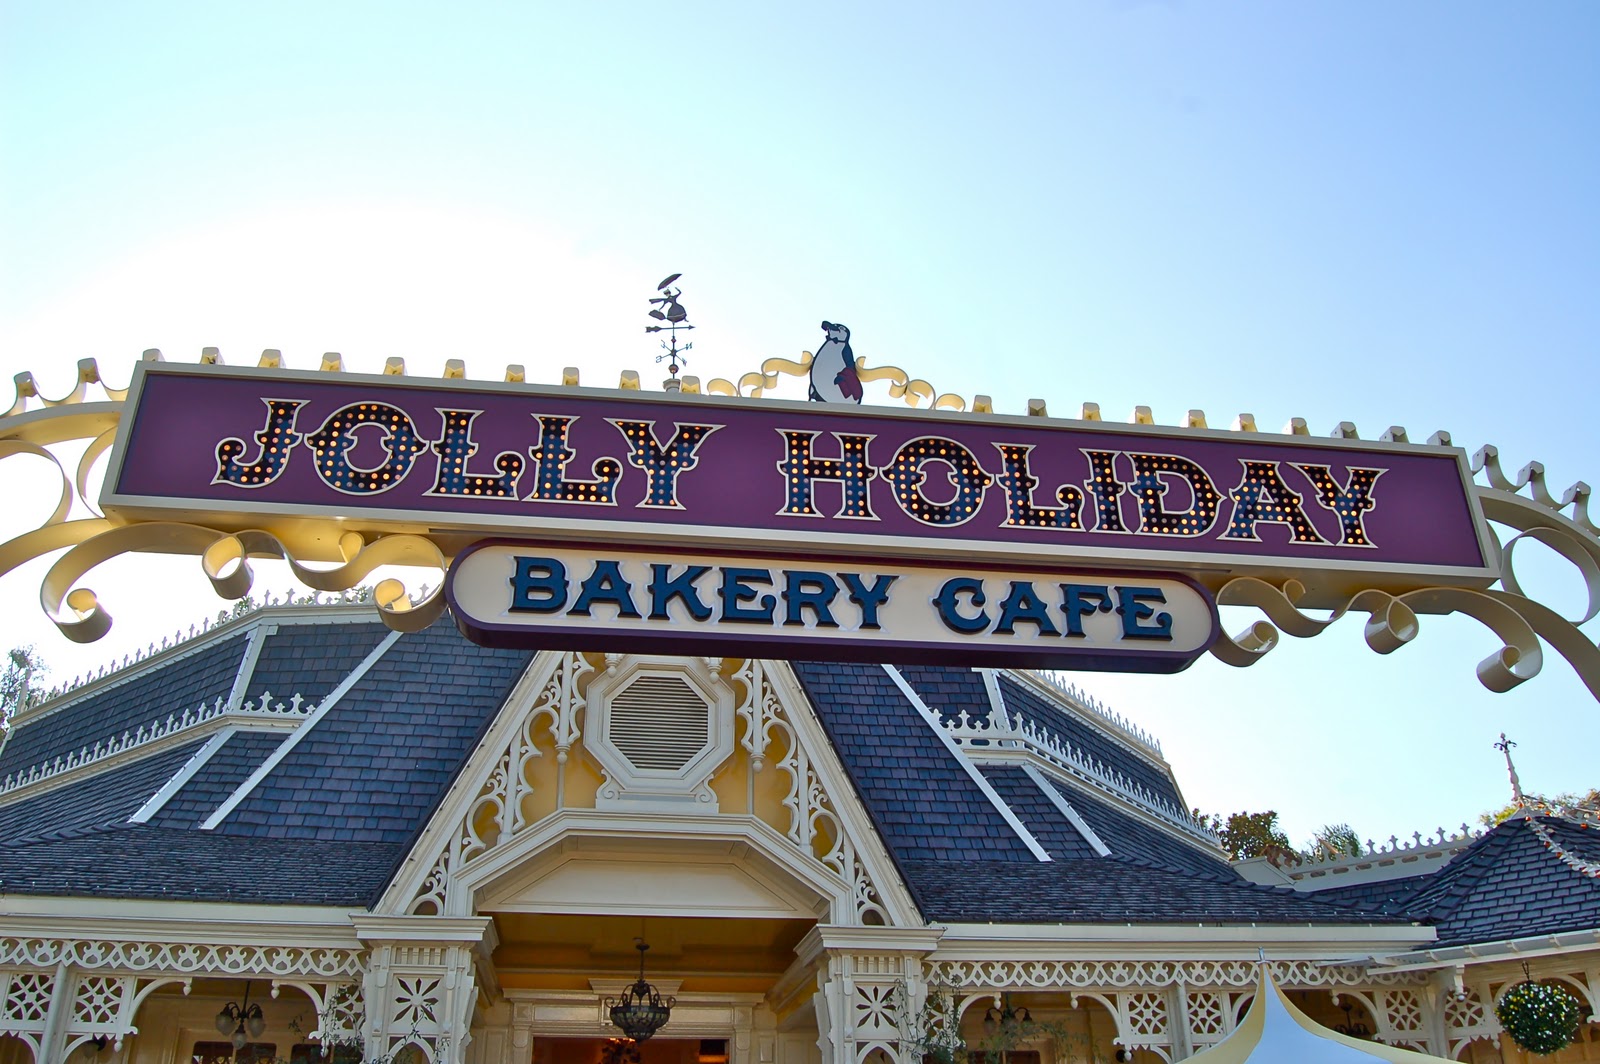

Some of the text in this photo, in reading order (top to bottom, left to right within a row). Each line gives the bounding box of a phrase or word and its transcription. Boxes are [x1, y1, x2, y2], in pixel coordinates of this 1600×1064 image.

[211, 397, 1389, 549] JOLLY HOLIDAY
[510, 555, 1174, 641] BAKERY CAFE
